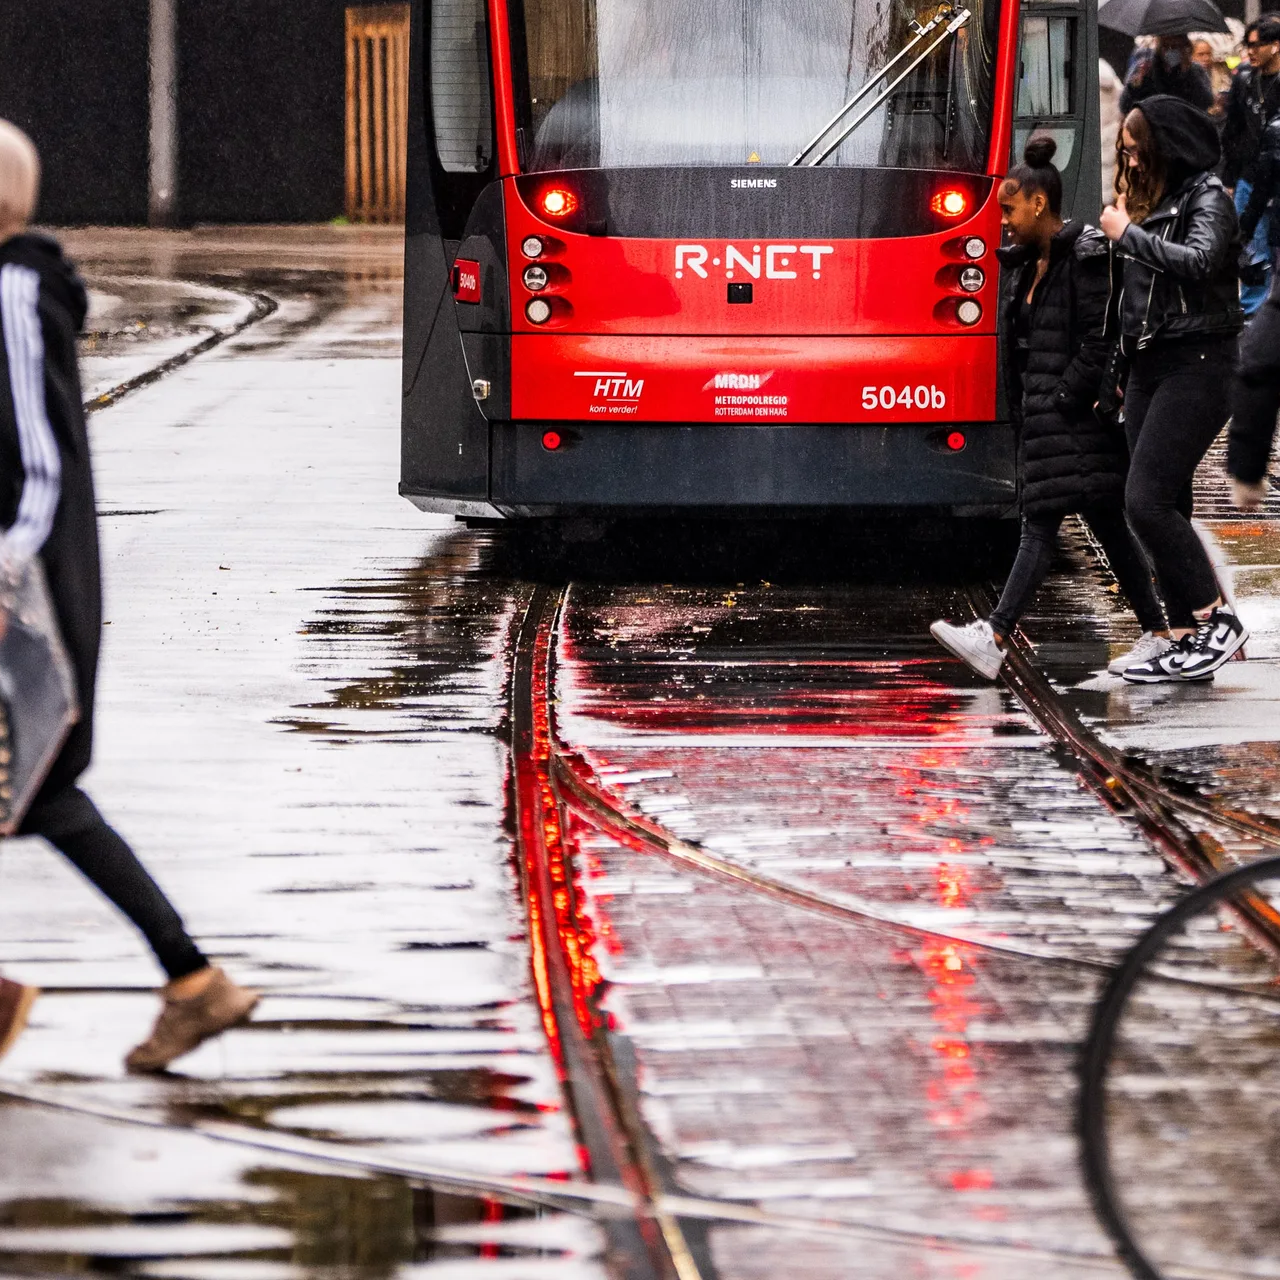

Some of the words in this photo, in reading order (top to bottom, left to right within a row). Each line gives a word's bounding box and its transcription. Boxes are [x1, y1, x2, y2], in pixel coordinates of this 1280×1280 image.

[730, 179, 777, 188] SIEMENS
[714, 374, 760, 389] MRDH
[593, 379, 644, 397] HTM
[714, 396, 788, 405] METROPOOLREGIO
[861, 385, 946, 410] 5040b
[589, 404, 607, 414] kom
[608, 405, 638, 414] verder!
[714, 407, 754, 416] ROTTERDAM
[754, 407, 768, 416] DEN
[769, 407, 788, 416] HAAG
